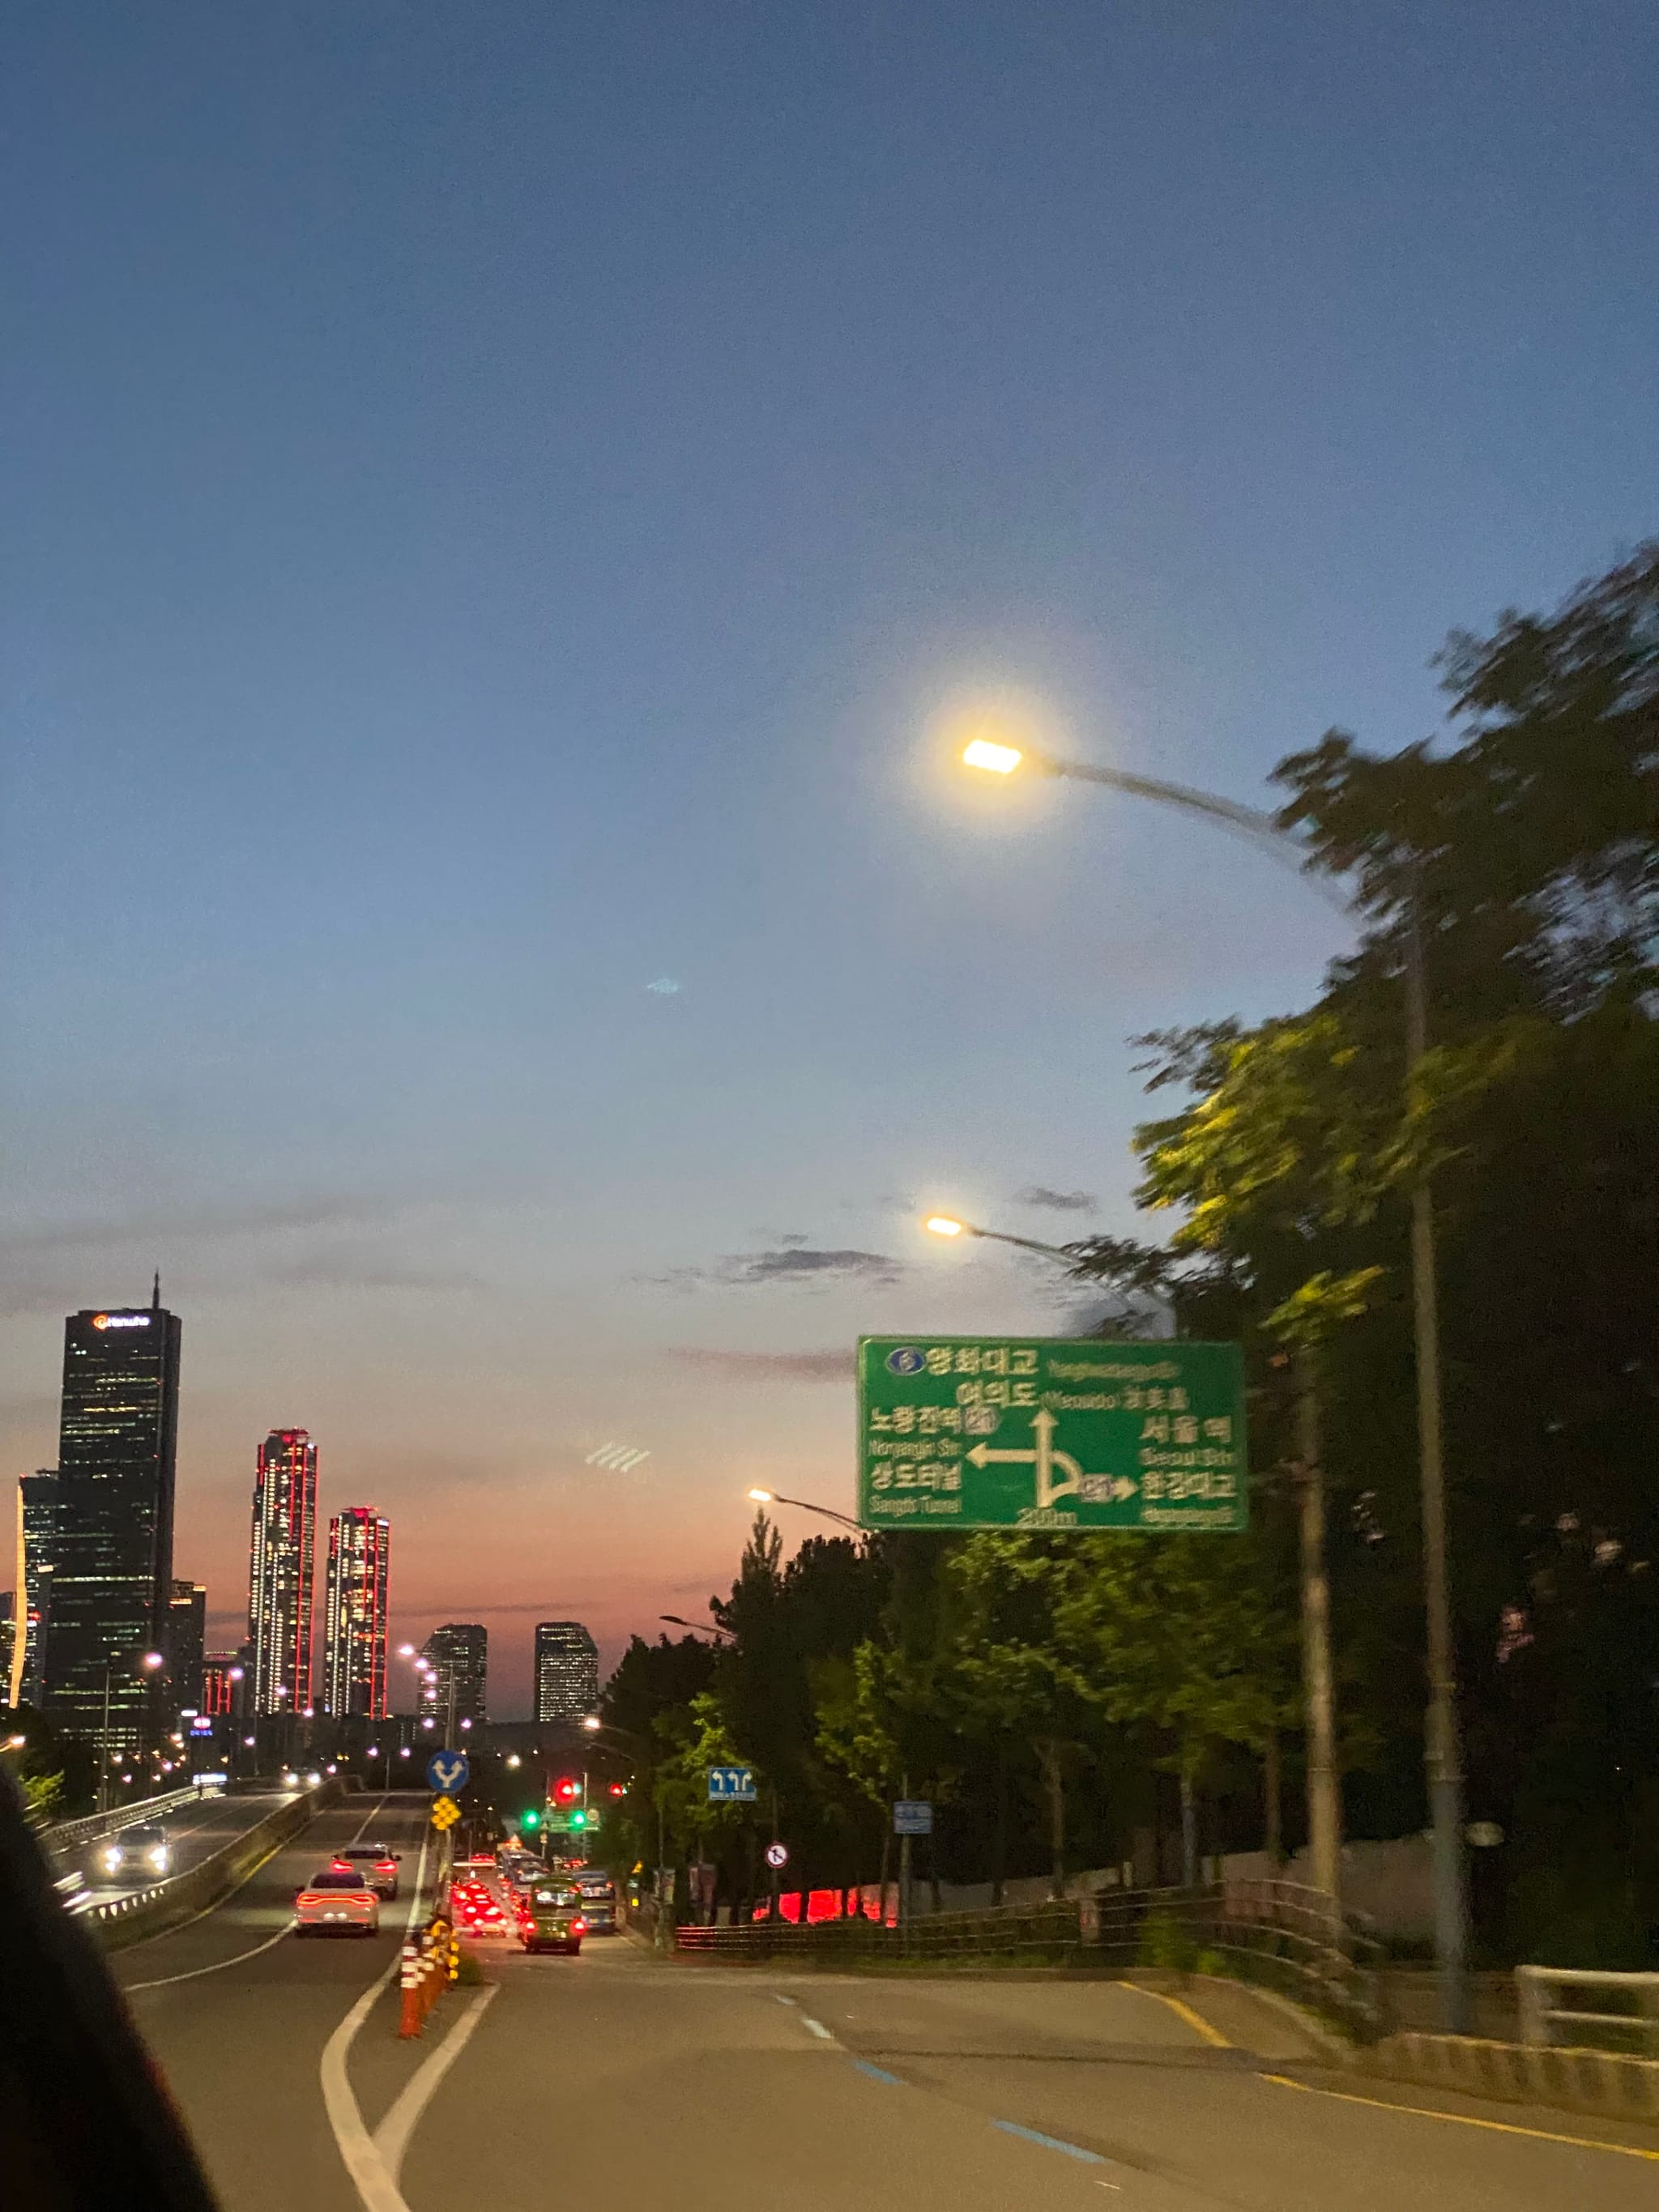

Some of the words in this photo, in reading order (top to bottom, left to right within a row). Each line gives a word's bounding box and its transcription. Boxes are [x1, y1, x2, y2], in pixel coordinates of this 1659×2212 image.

[956, 1379, 1039, 1408] 여의도
[870, 1405, 962, 1434] 노량진역
[871, 1461, 962, 1491] 상도터널
[1141, 1470, 1236, 1500] 한강대교
